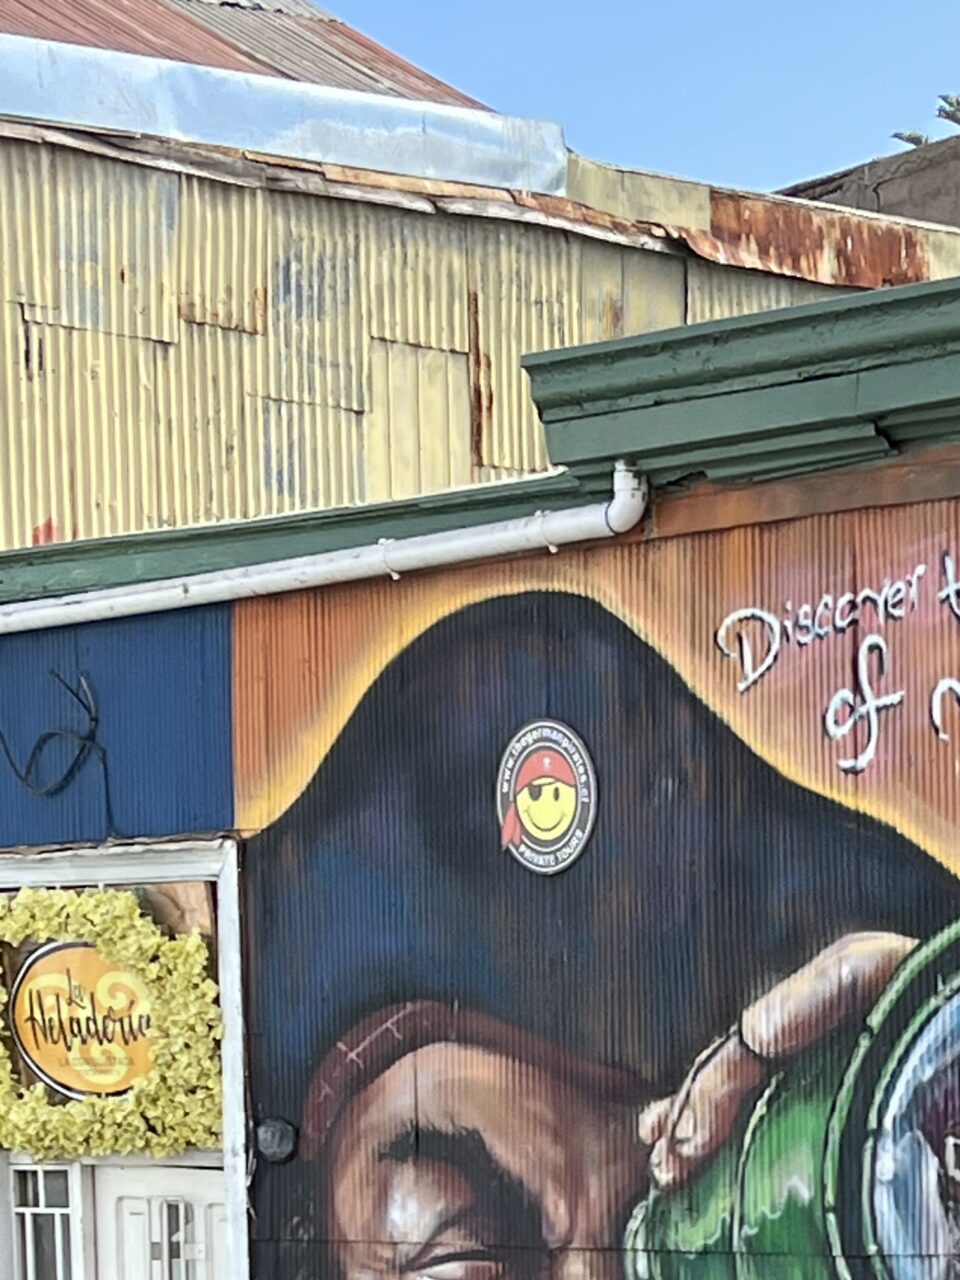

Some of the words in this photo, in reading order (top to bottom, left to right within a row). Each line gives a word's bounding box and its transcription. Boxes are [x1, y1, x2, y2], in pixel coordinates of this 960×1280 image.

[715, 563, 926, 692] Discover
[823, 634, 904, 774] of
[518, 843, 556, 866] PRIVATE
[556, 829, 584, 862] TOURS
